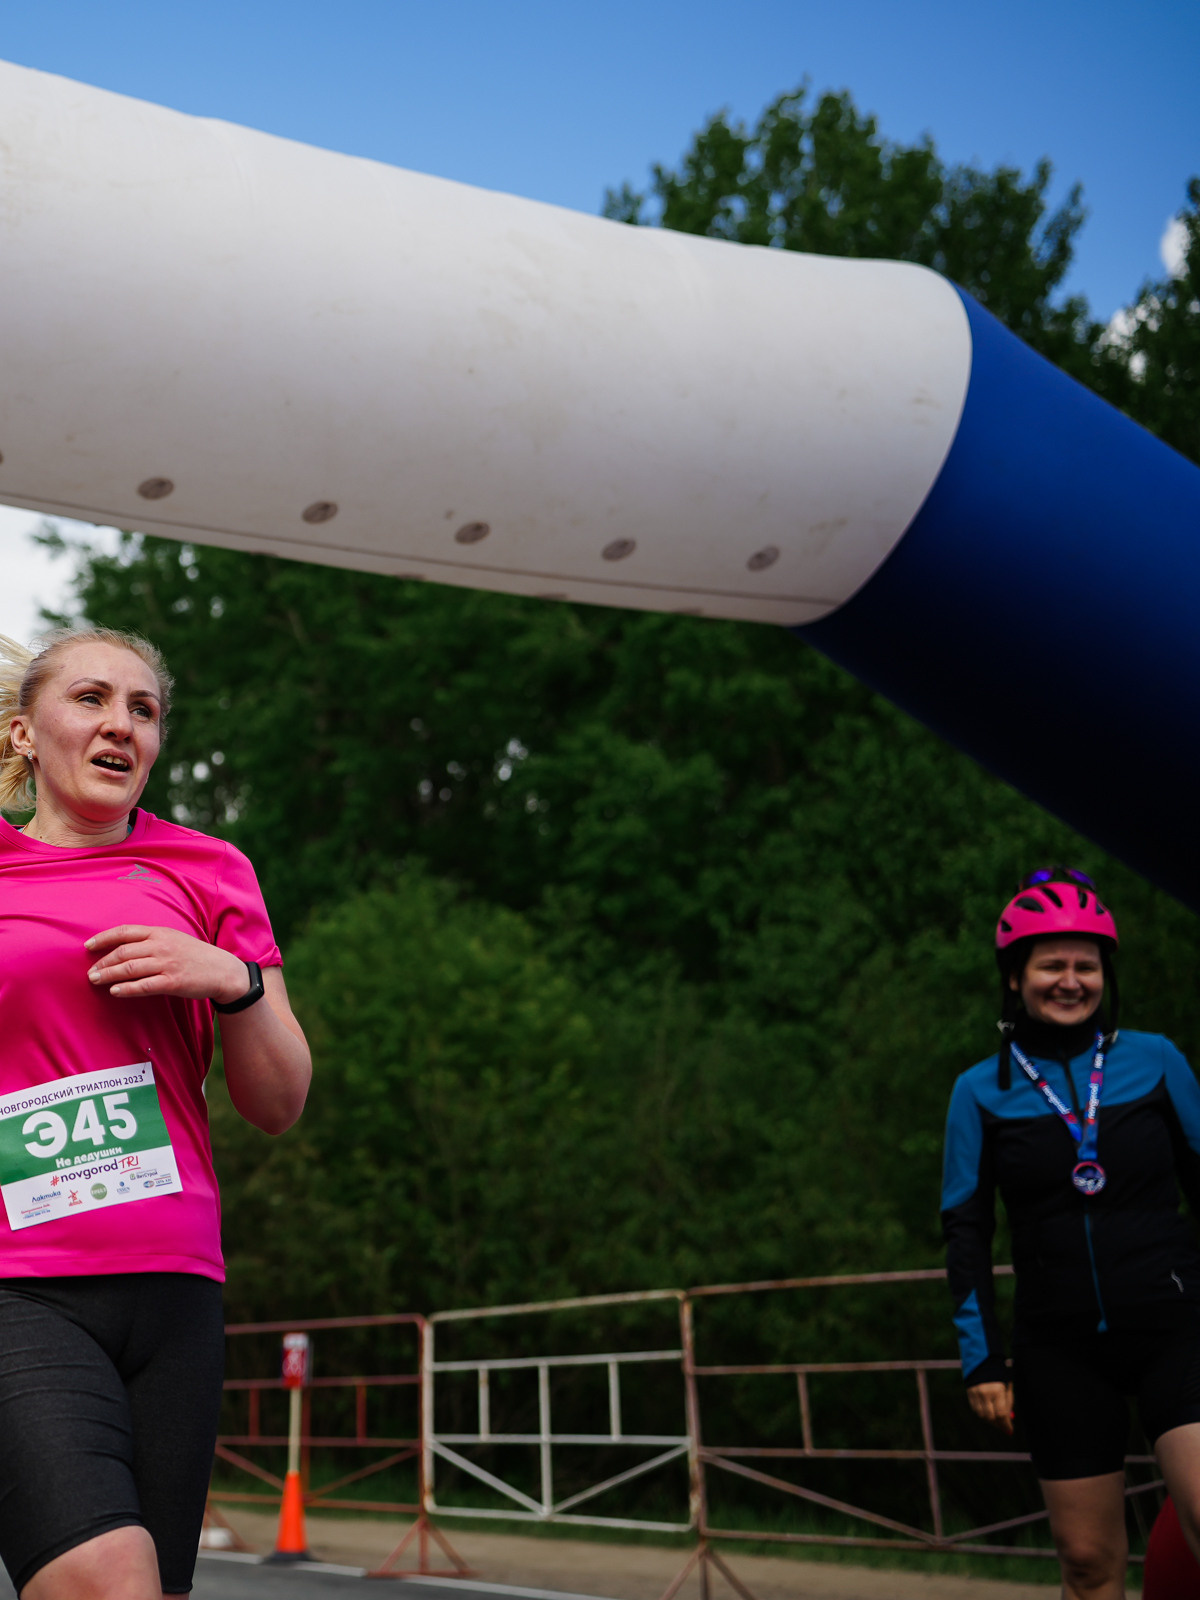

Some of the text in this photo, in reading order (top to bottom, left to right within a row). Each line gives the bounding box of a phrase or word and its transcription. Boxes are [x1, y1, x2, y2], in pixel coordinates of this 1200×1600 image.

[75, 1078, 122, 1095] ТРИАТЛОН
[124, 1074, 144, 1085] 2023
[22, 1092, 138, 1158] Э45
[55, 1146, 123, 1168] Не дедушки
